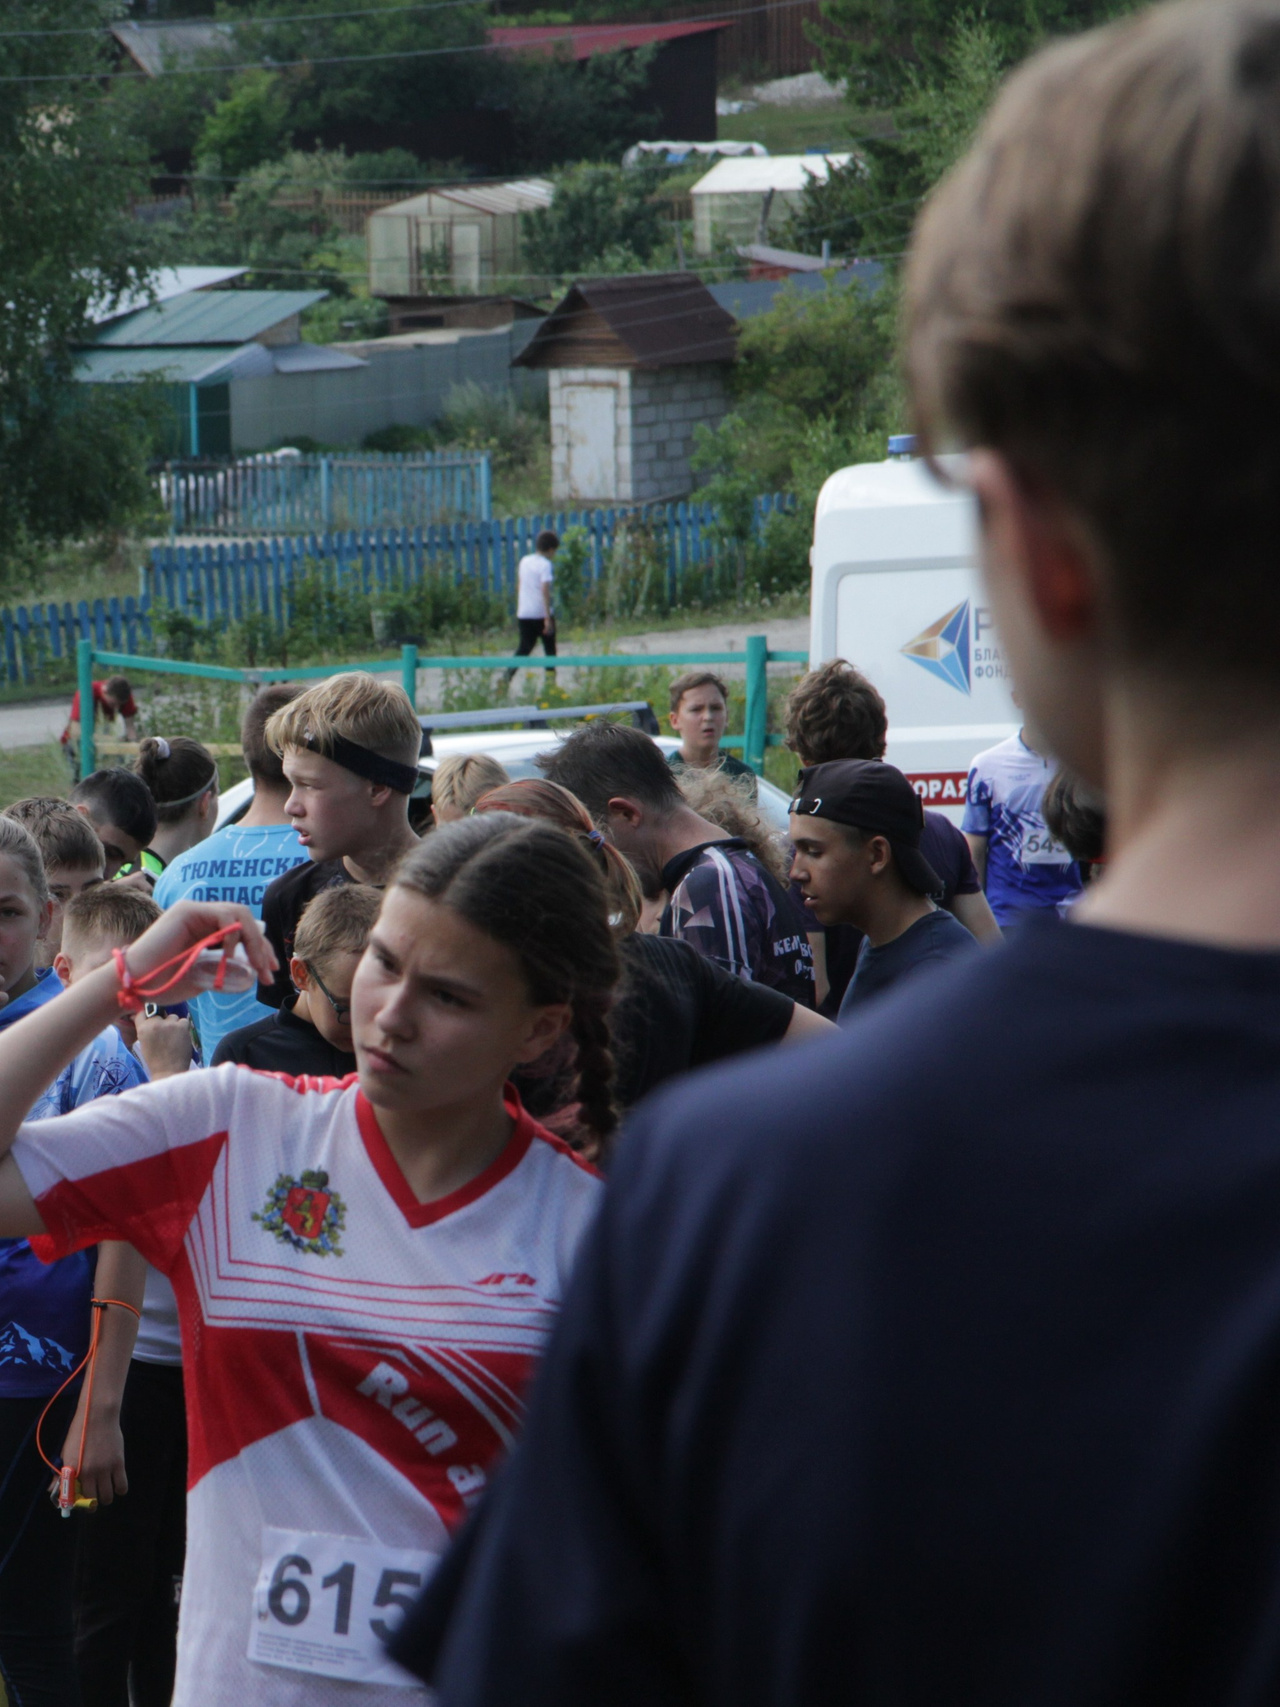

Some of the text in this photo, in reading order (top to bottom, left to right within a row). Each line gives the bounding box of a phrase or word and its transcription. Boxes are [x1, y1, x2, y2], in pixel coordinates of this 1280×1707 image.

[974, 648, 1002, 662] БЛА
[909, 778, 969, 799] ОРАЯ
[192, 885, 266, 906] ОБЛАС
[355, 1361, 458, 1456] Run
[268, 1553, 422, 1637] 615
